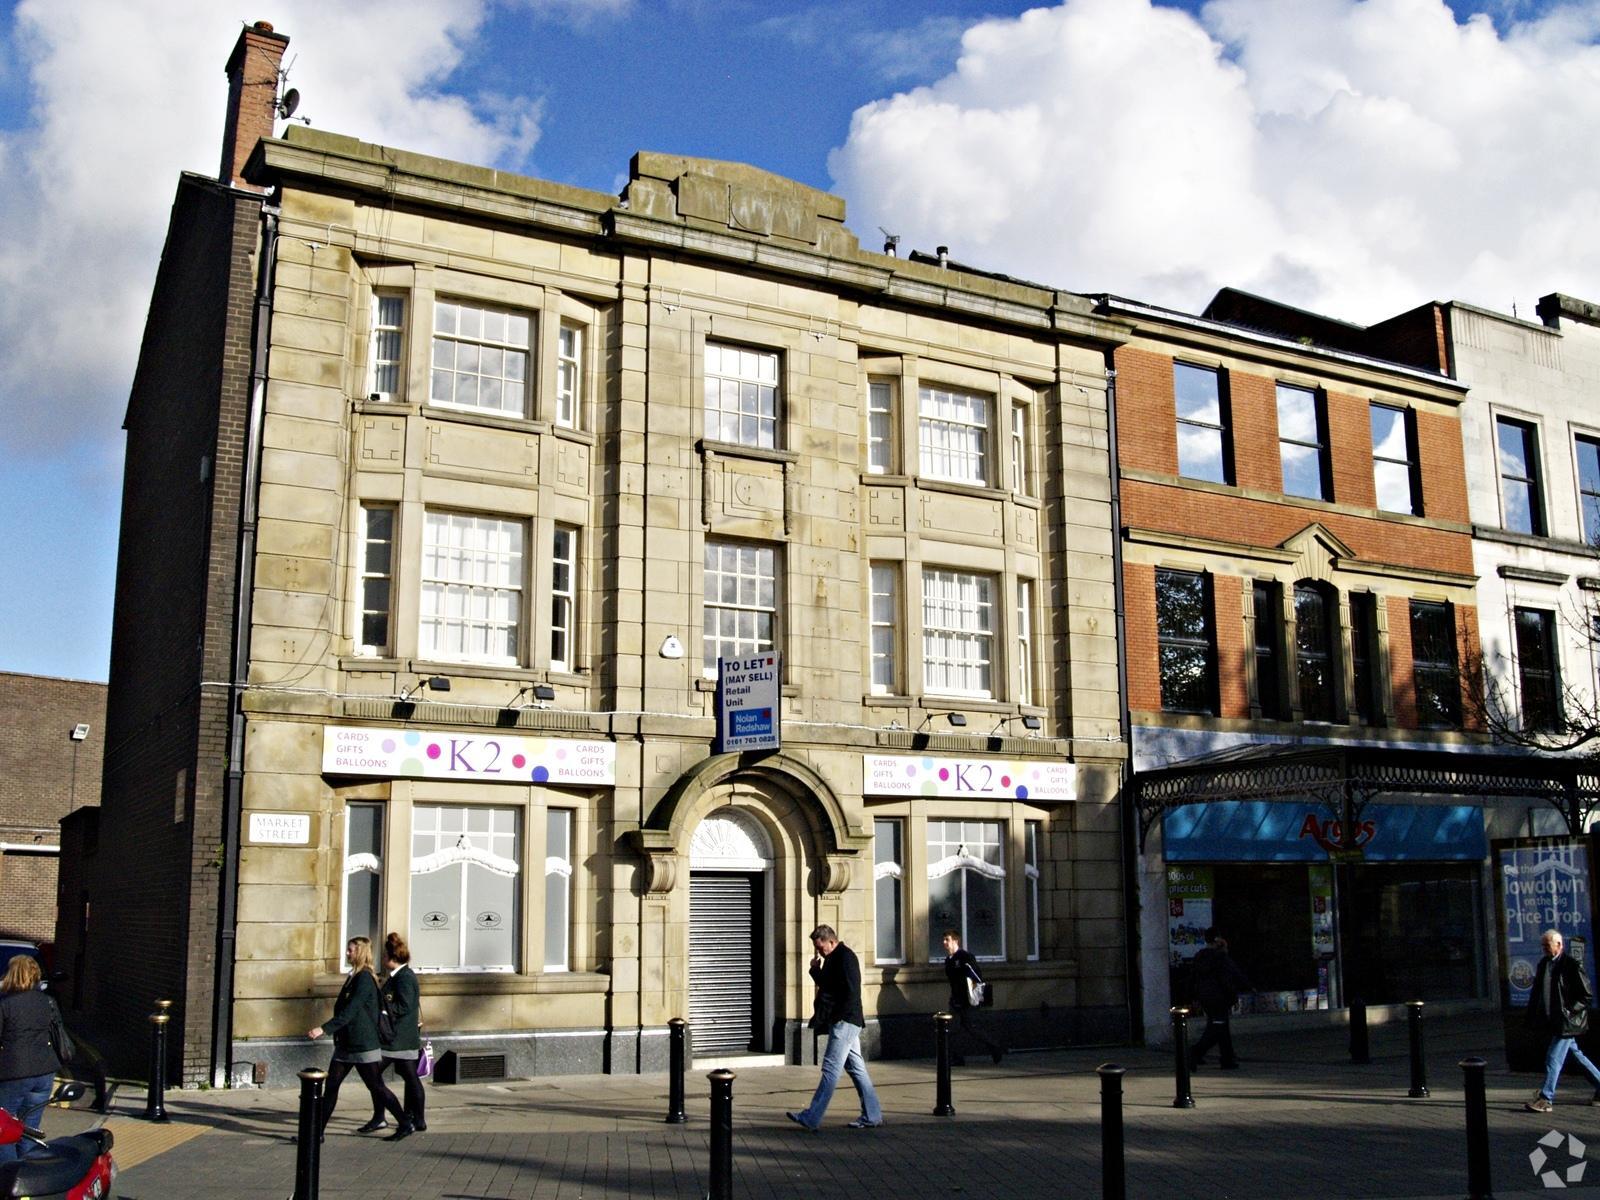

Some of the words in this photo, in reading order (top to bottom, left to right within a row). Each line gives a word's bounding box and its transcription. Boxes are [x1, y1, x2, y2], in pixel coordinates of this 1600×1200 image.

[725, 661, 740, 672] TO
[744, 658, 765, 670] LET
[725, 674, 746, 686] (MAY
[748, 672, 773, 682] SELL)
[726, 686, 751, 696] Retail
[726, 698, 743, 707] Unit
[336, 732, 370, 742] CARDS
[336, 744, 364, 754] GIFTS
[576, 744, 606, 754] CARDS
[336, 757, 388, 768] BALLOONS
[580, 756, 605, 766] GIFTS
[873, 759, 897, 768] CARDS
[558, 767, 605, 778] BALLOONS
[873, 770, 894, 779] GIFTS
[1046, 767, 1068, 775] CARDS
[1050, 776, 1068, 784] GIFTS
[873, 781, 912, 790] BALLOONS
[1034, 786, 1069, 795] BALLOONS
[256, 817, 304, 828] MARKET
[258, 829, 301, 839] STREET
[1505, 875, 1586, 895] lowdown
[1506, 908, 1542, 924] Price
[1545, 907, 1586, 927] Drop.
